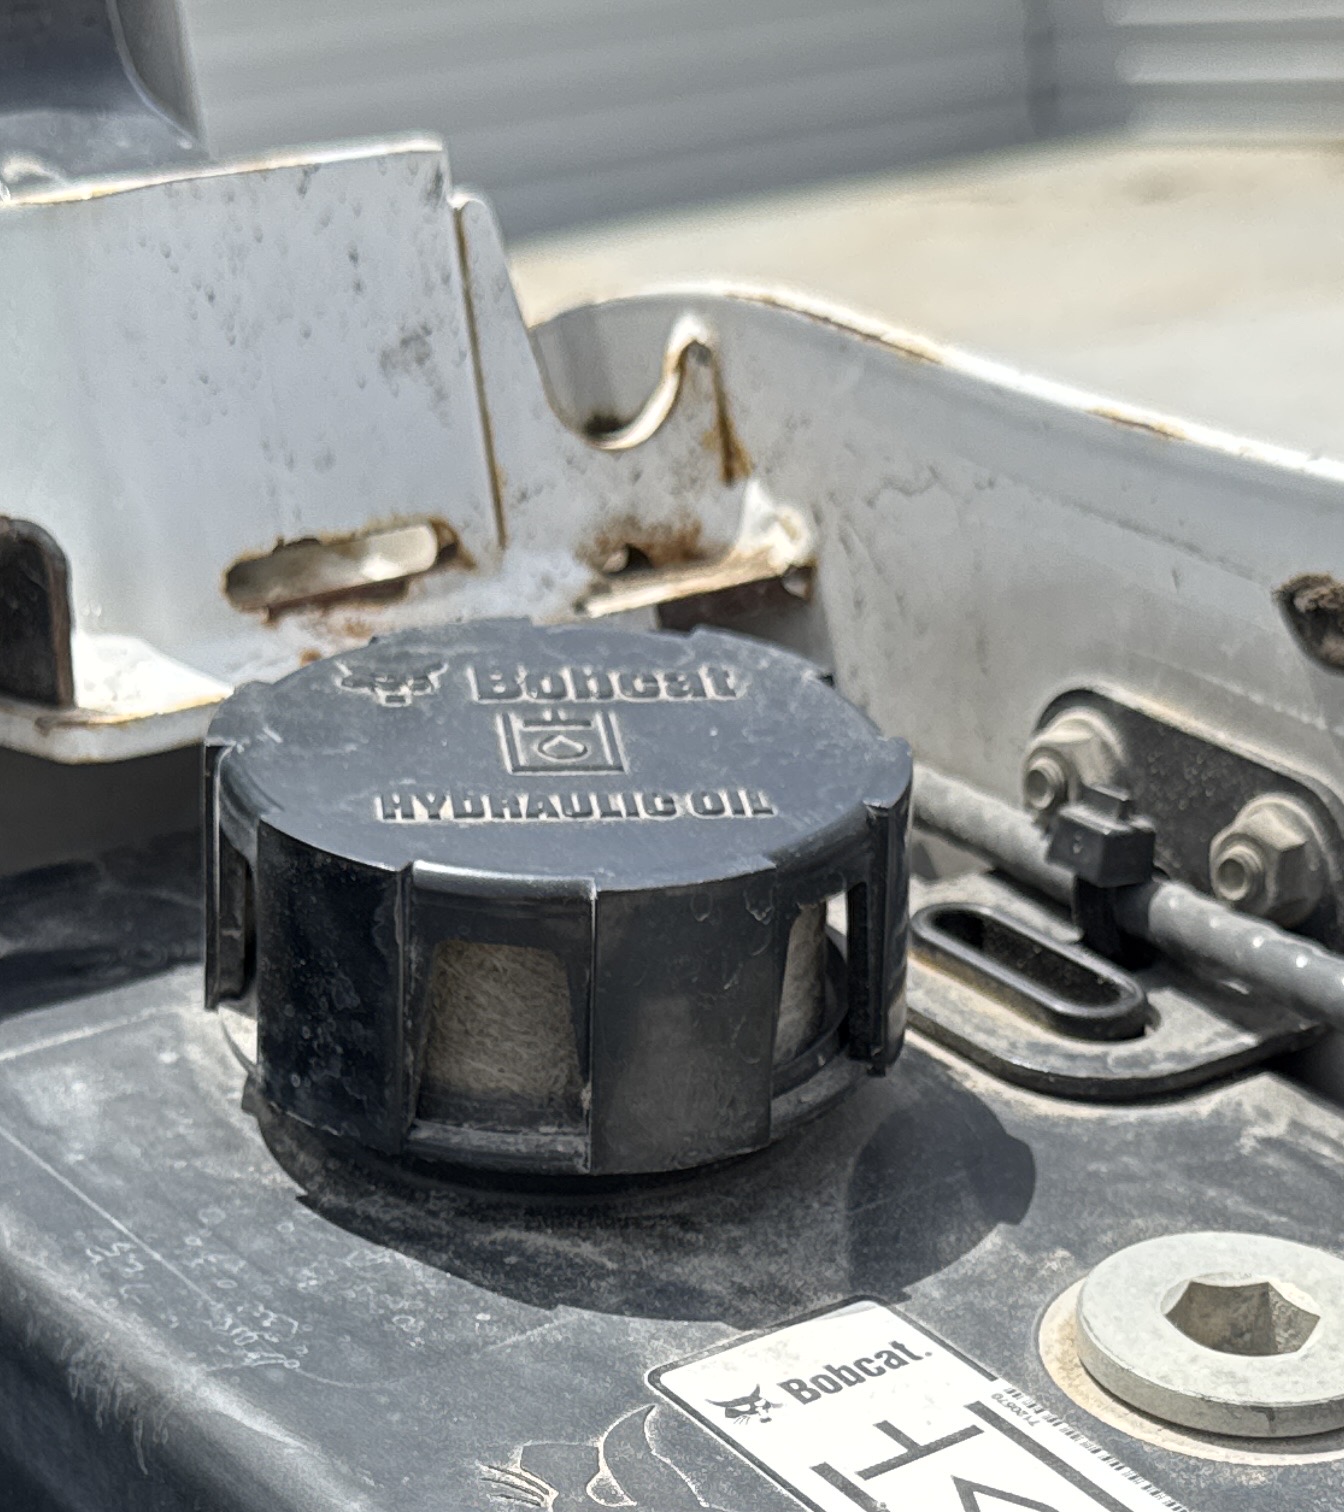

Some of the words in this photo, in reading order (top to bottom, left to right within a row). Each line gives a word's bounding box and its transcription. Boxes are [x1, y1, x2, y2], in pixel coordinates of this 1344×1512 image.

[468, 665, 746, 703] Bobcat
[374, 790, 677, 822] HYDRAULIC
[687, 788, 776, 819] OIL
